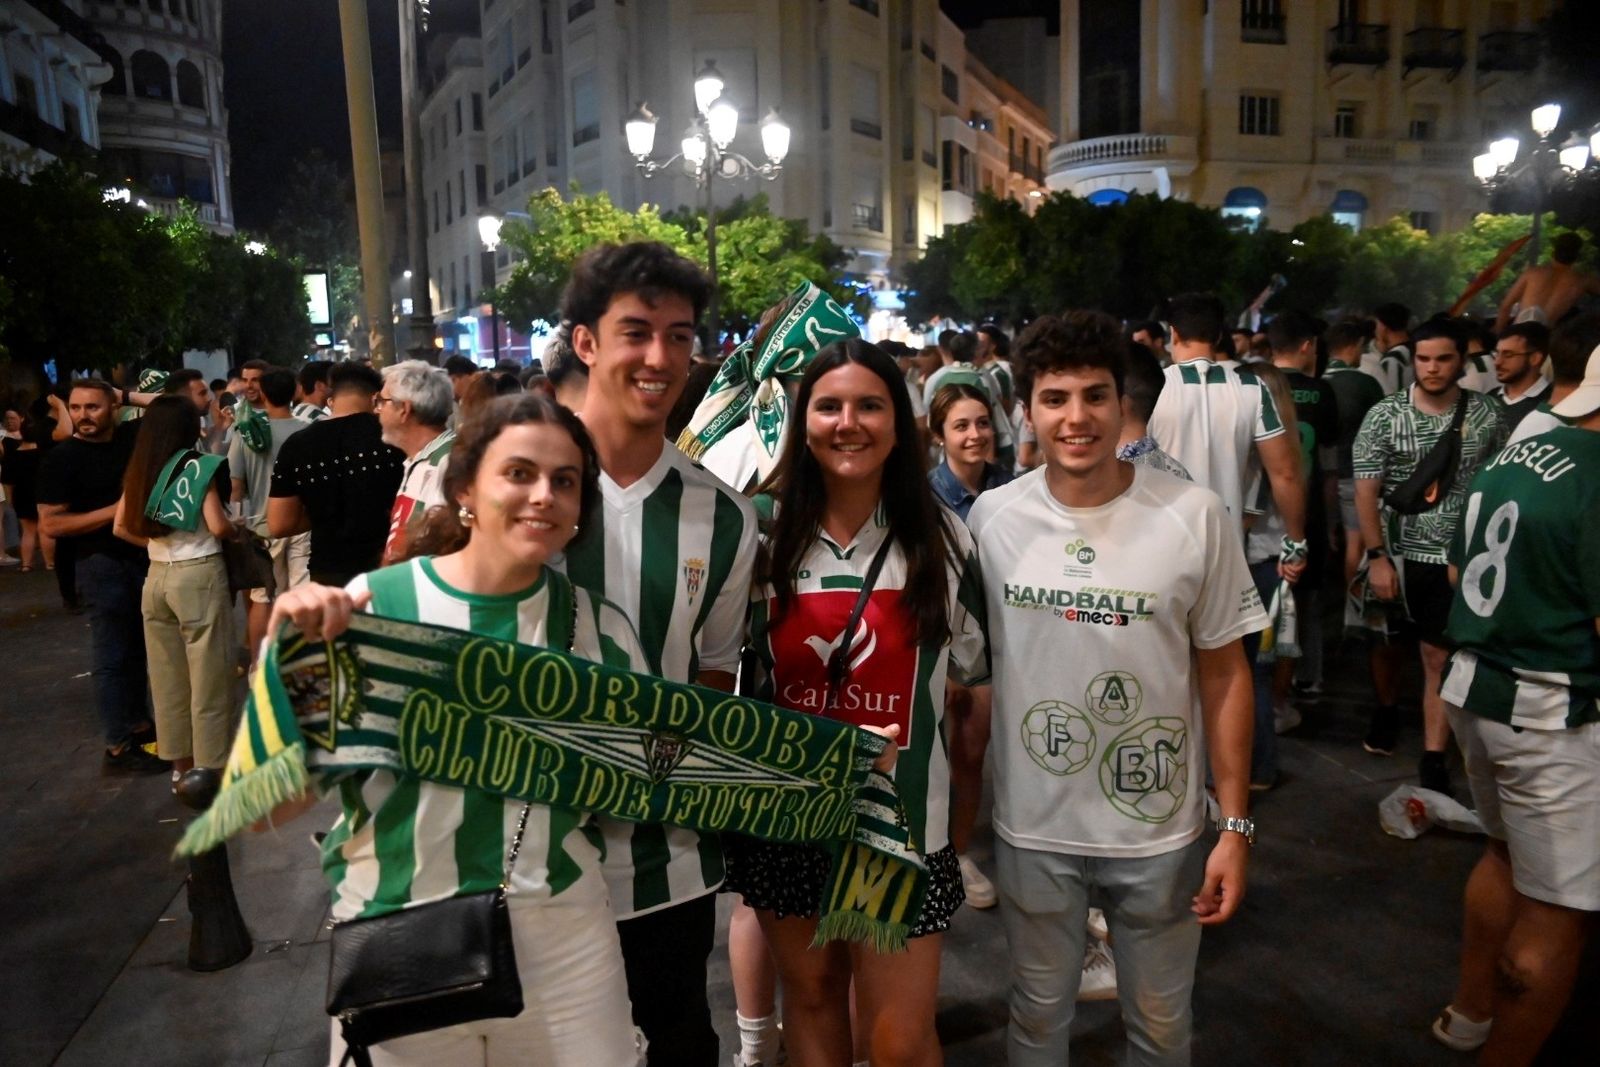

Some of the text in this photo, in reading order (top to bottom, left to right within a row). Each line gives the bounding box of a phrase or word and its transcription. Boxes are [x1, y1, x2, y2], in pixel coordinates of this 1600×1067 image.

[1485, 441, 1576, 482] JOSELU
[1079, 551, 1094, 561] BM
[1461, 491, 1519, 618] 18
[1004, 583, 1155, 616] HANDBALL
[1053, 607, 1115, 626] by emec
[457, 638, 858, 789] CORDOBA
[1099, 675, 1129, 711] A
[400, 689, 564, 802] CLUB
[570, 755, 650, 821] DE
[1047, 714, 1072, 758] F
